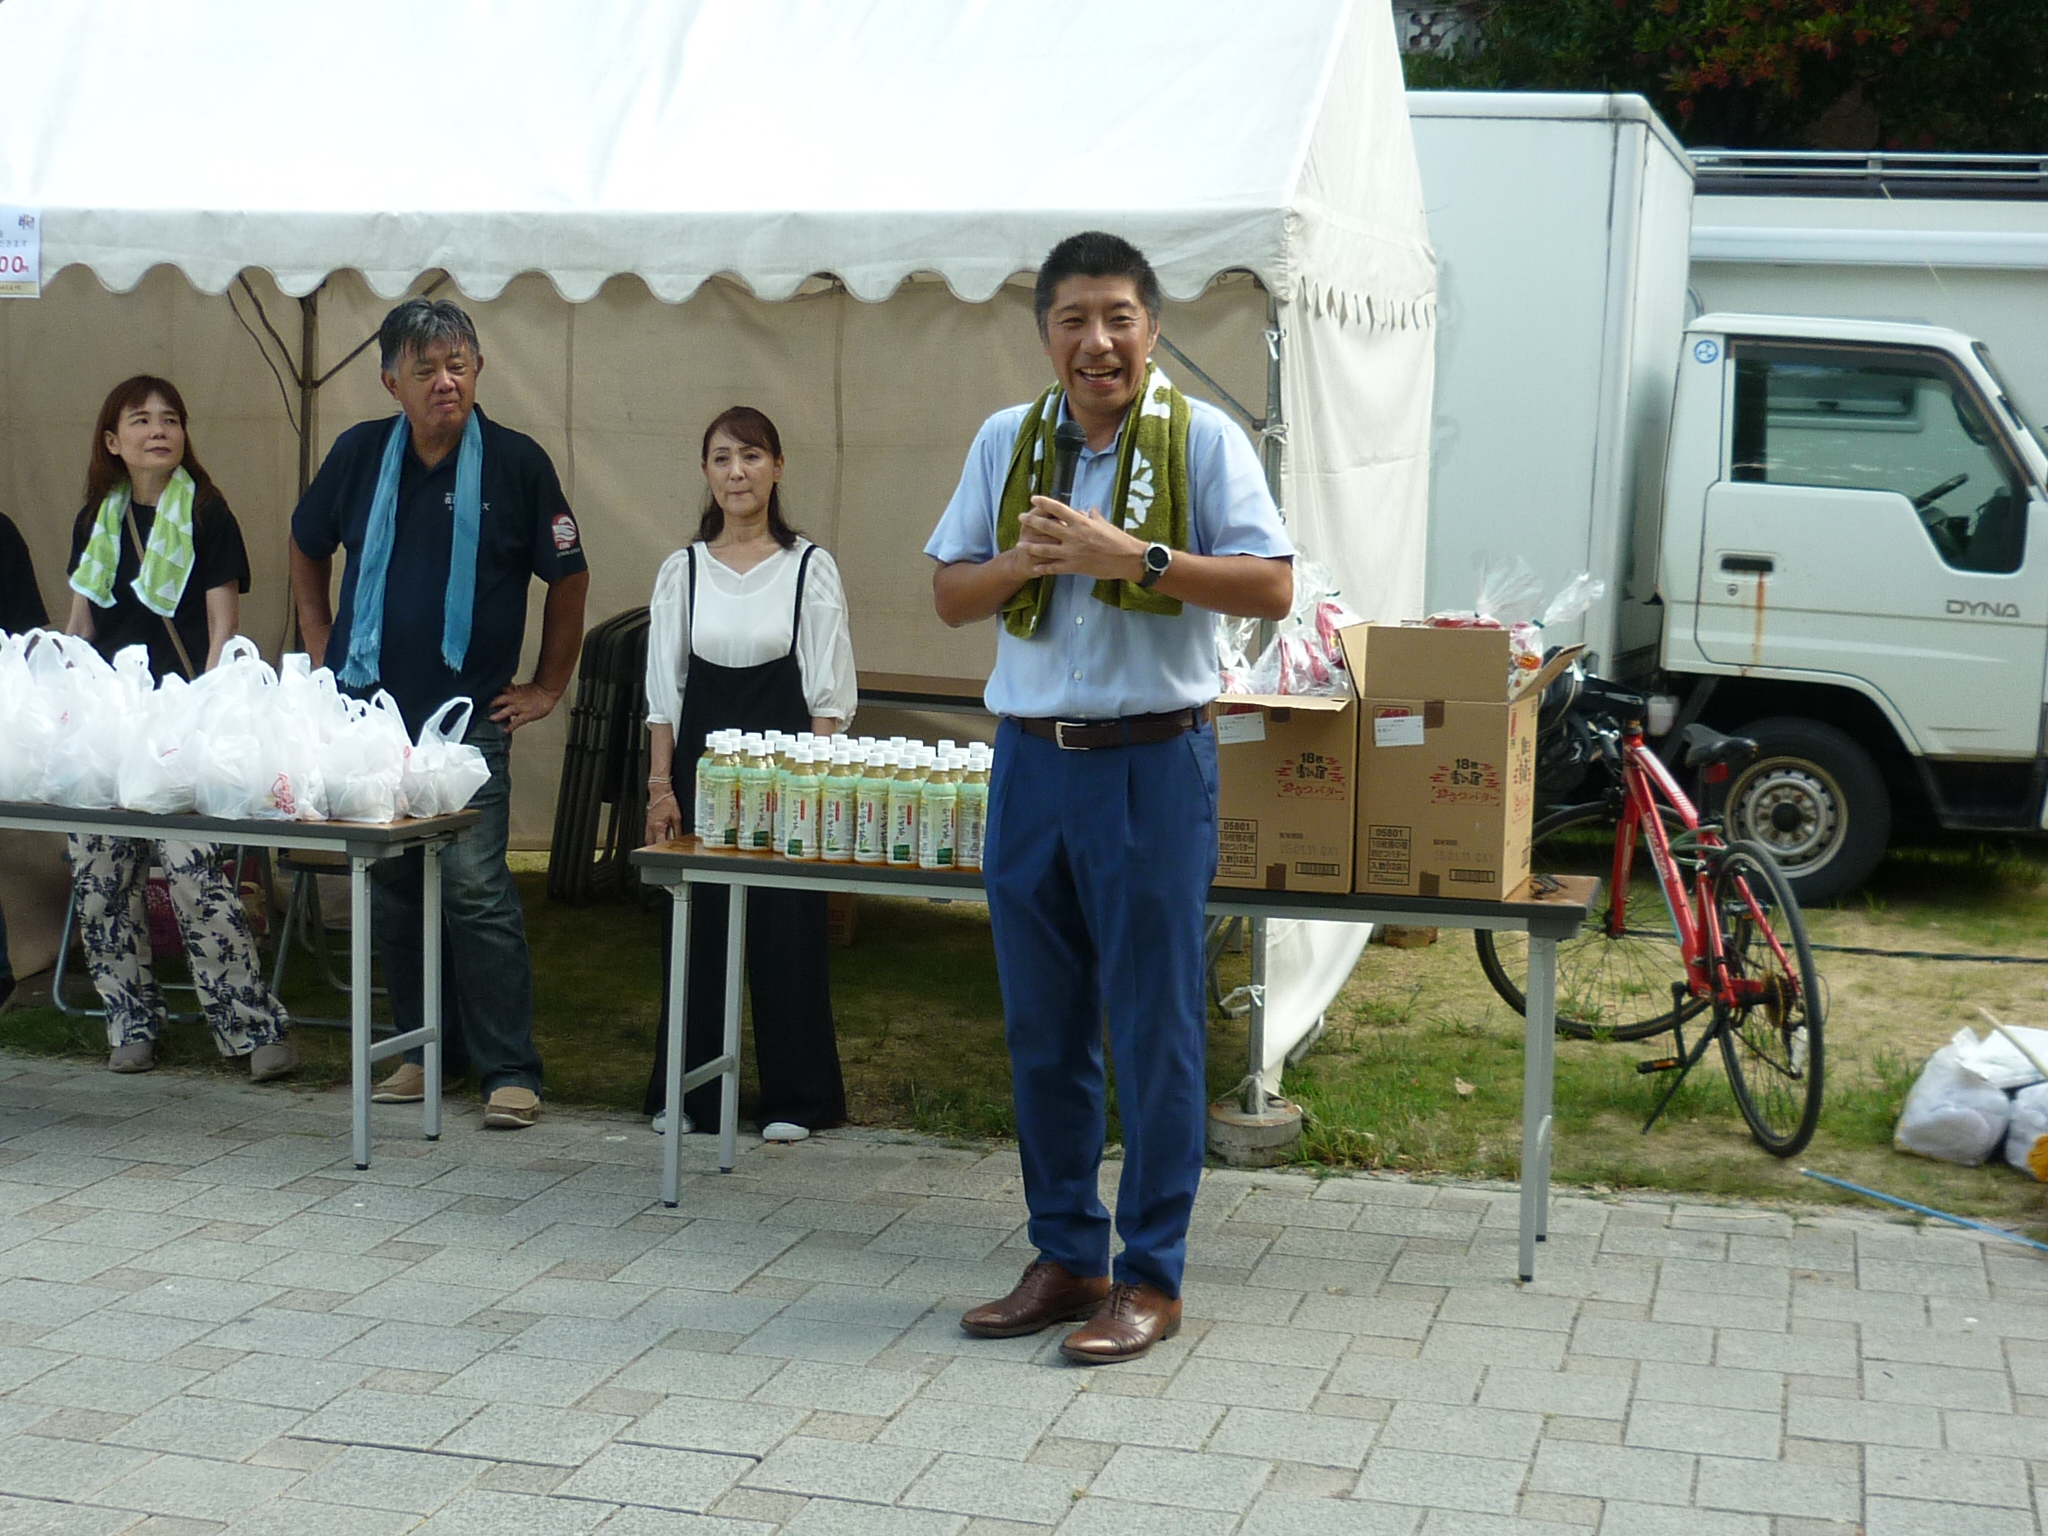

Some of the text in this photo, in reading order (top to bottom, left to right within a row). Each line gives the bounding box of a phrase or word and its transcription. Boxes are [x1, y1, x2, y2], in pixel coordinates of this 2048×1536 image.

[1946, 599, 2021, 619] DYNA
[1223, 821, 1250, 831] 05801
[1375, 828, 1403, 837] 05801
